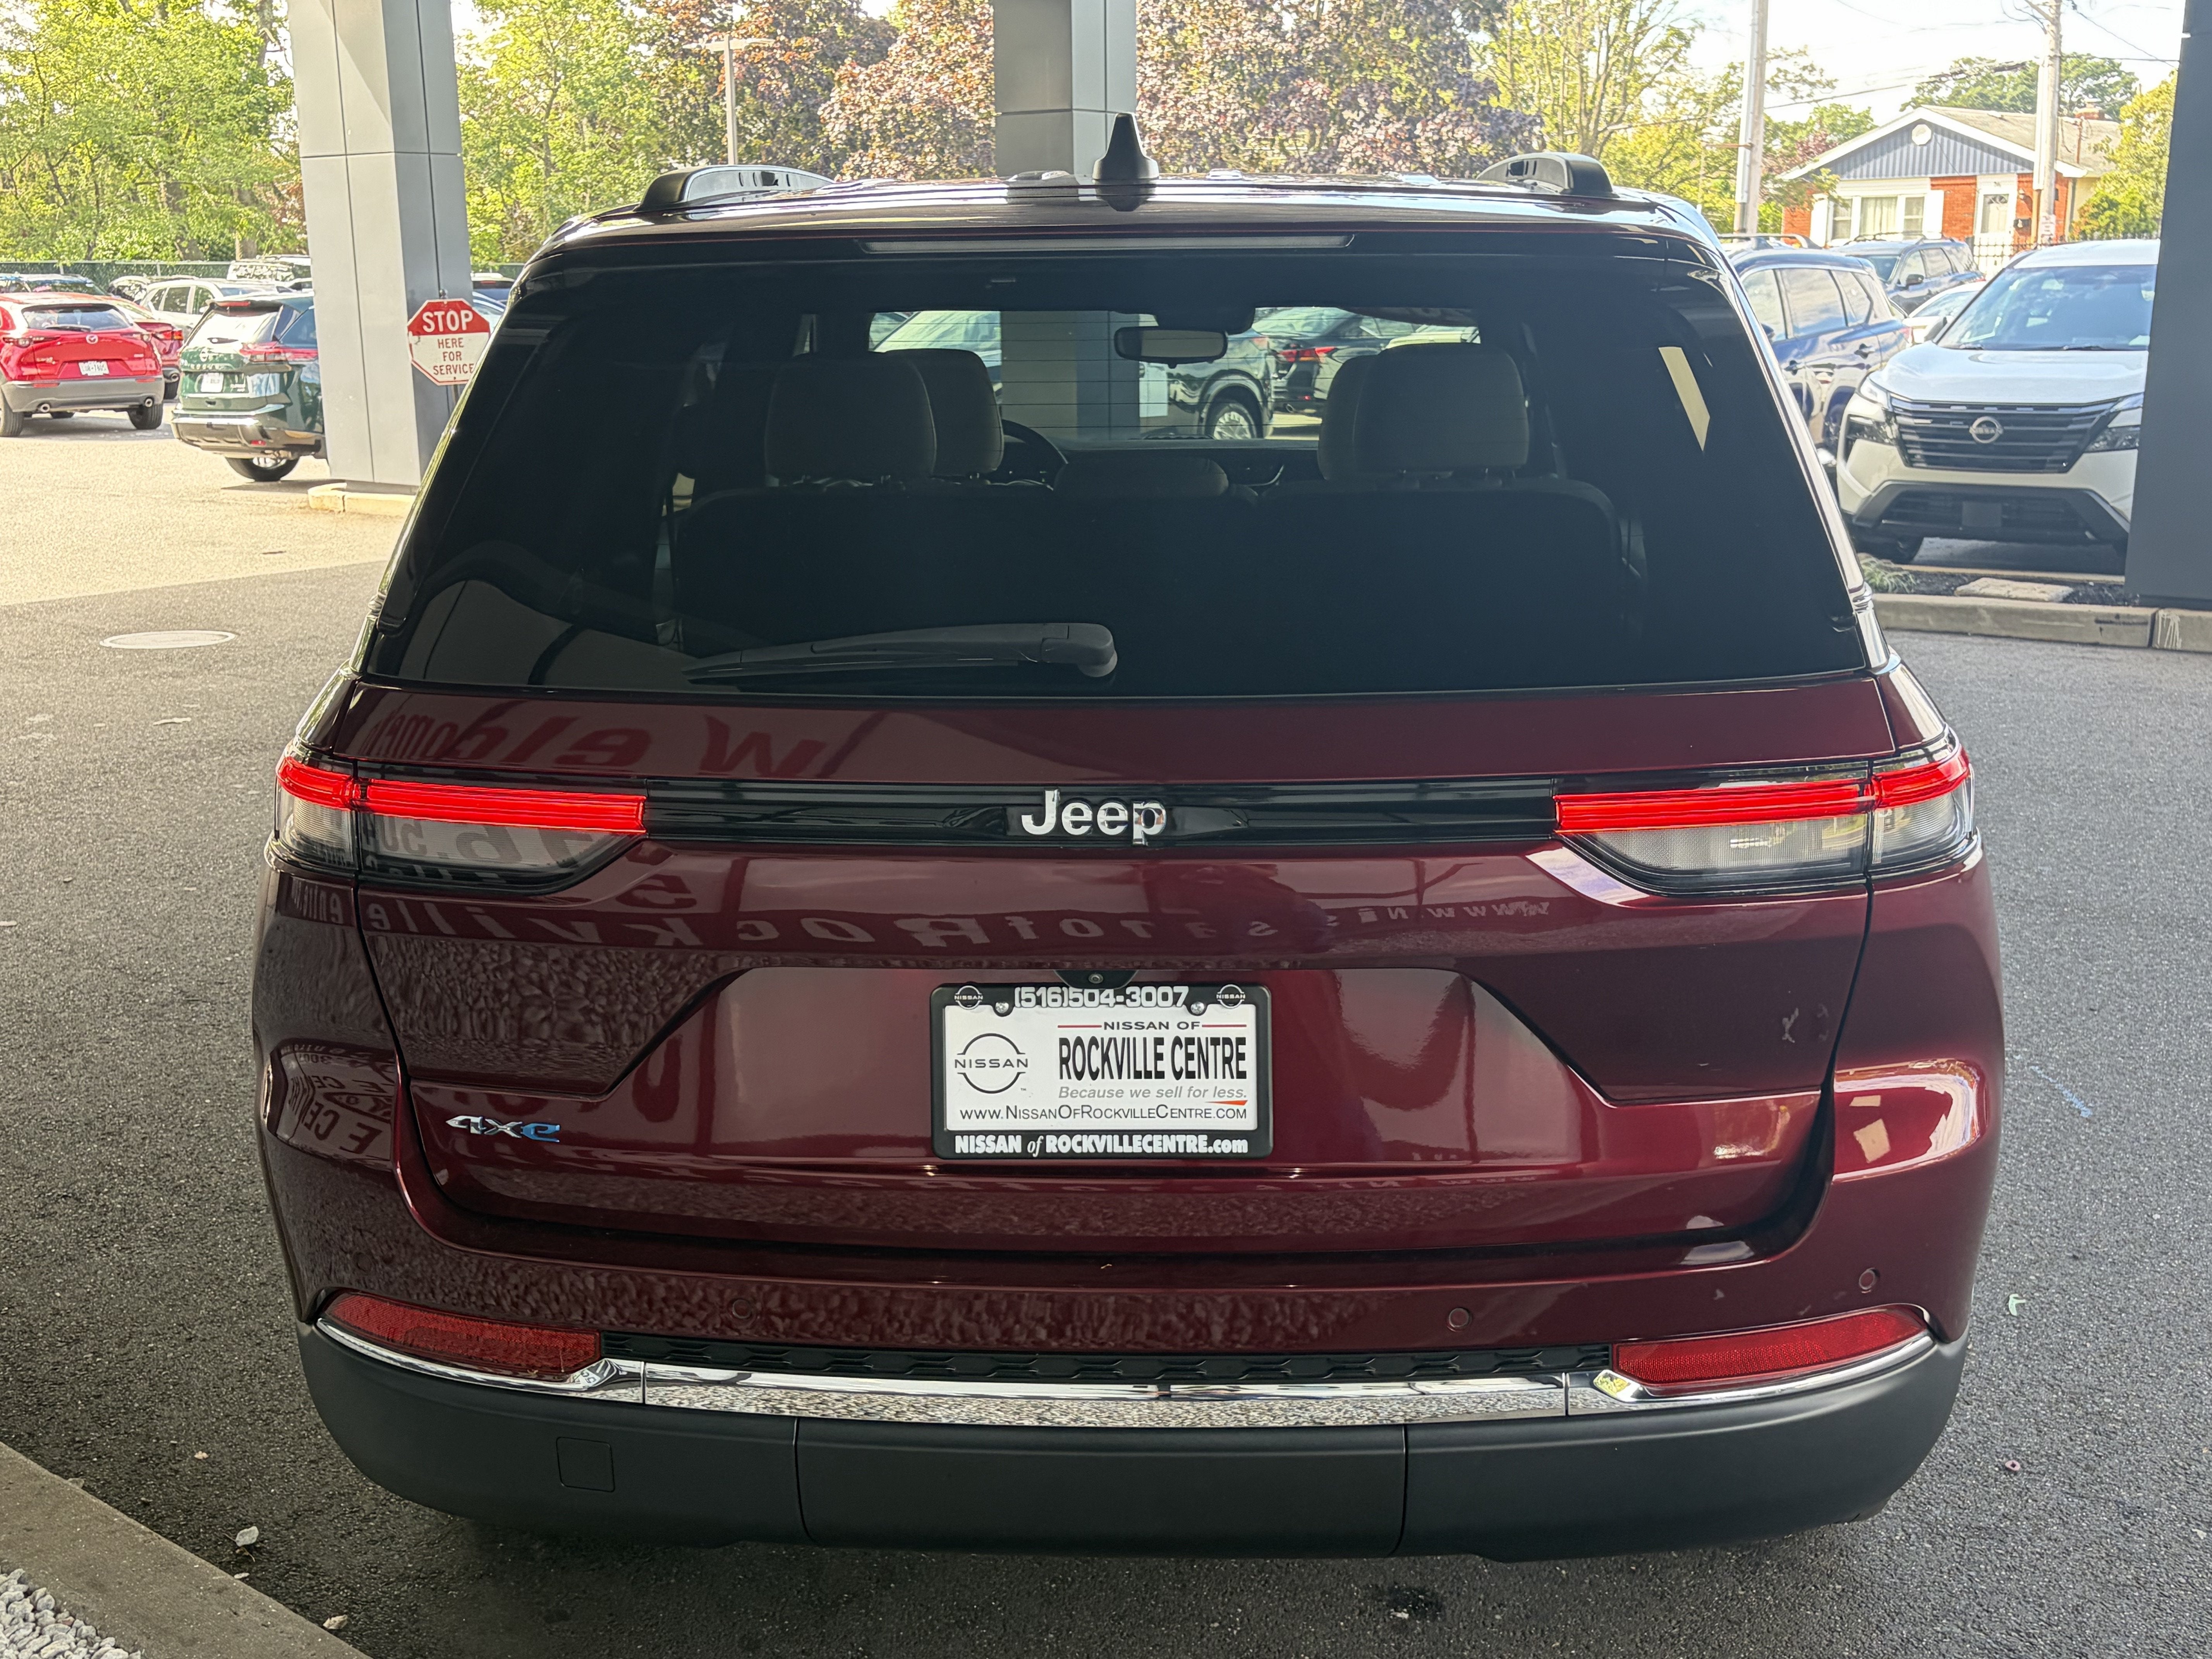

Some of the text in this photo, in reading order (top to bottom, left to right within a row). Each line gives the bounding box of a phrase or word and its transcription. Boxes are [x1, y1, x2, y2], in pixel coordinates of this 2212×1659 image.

[422, 309, 474, 333] STOP
[437, 337, 464, 349] HERE
[443, 351, 462, 362] FOR
[433, 363, 474, 375] SERVICE
[1021, 788, 1166, 846] Jeep
[1015, 986, 1189, 1008] (516)504-3007
[1104, 1021, 1200, 1030] NISSAN OF
[955, 1059, 1028, 1068] NISSAN
[1059, 1036, 1247, 1081] ROCKVILLE CENTRE
[1059, 1086, 1247, 1098] Because we sell for less.
[955, 1134, 1248, 1158] NISSAN of ROCKVILLECENTRE.com
